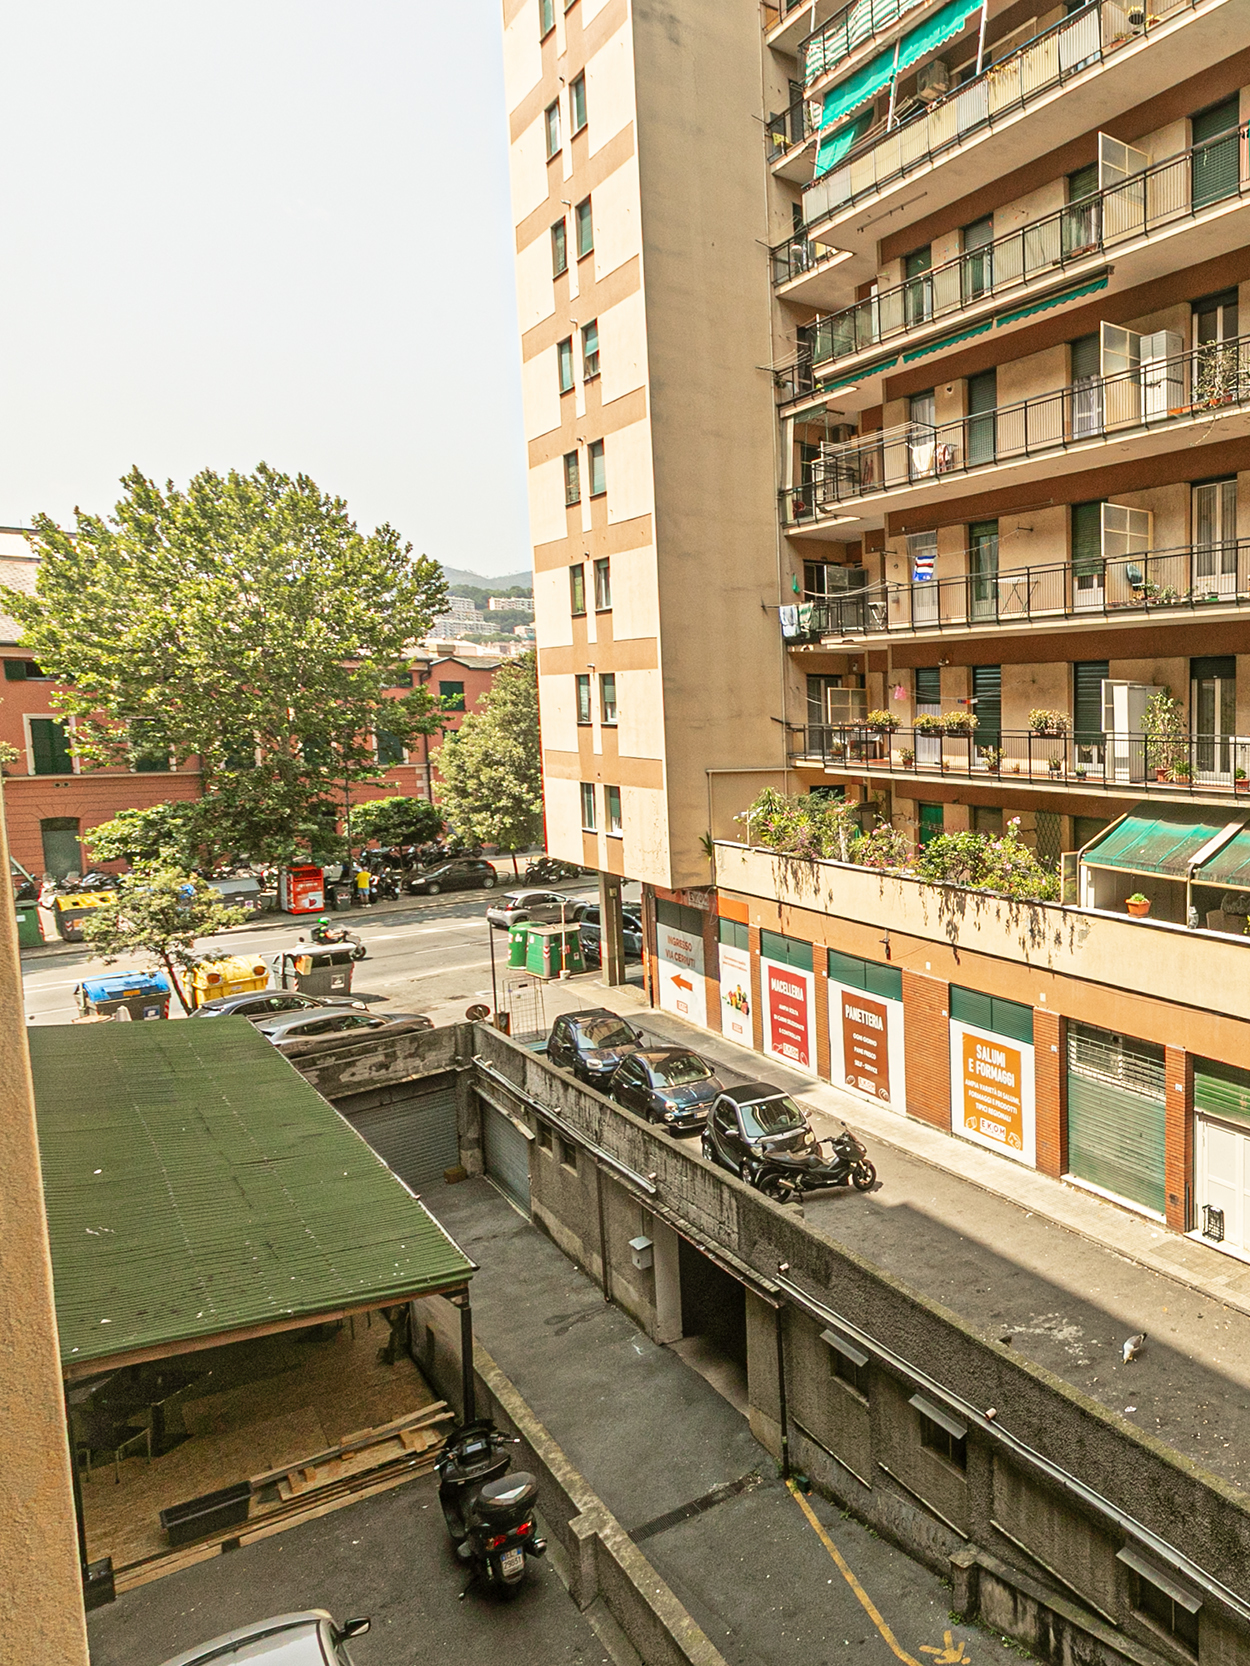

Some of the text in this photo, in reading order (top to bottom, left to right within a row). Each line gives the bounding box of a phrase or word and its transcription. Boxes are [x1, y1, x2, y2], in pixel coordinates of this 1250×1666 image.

[667, 935, 693, 952] INGRESSO
[665, 948, 696, 968] VIA CERRUTI
[771, 978, 804, 1001] MACELLERIA
[845, 1004, 884, 1031] PANETTERIA
[976, 1044, 1005, 1068] SALUMI
[968, 1058, 1015, 1087] E FORMAGGI
[965, 1078, 979, 1089] AMPIA
[979, 1082, 997, 1095] VARIETÀ
[968, 1089, 992, 1105] FORMAGGI
[995, 1098, 1018, 1115] PRODOTTI
[975, 1102, 1012, 1123] TIPICI REGIONALI
[981, 1119, 1005, 1134] EKOM
